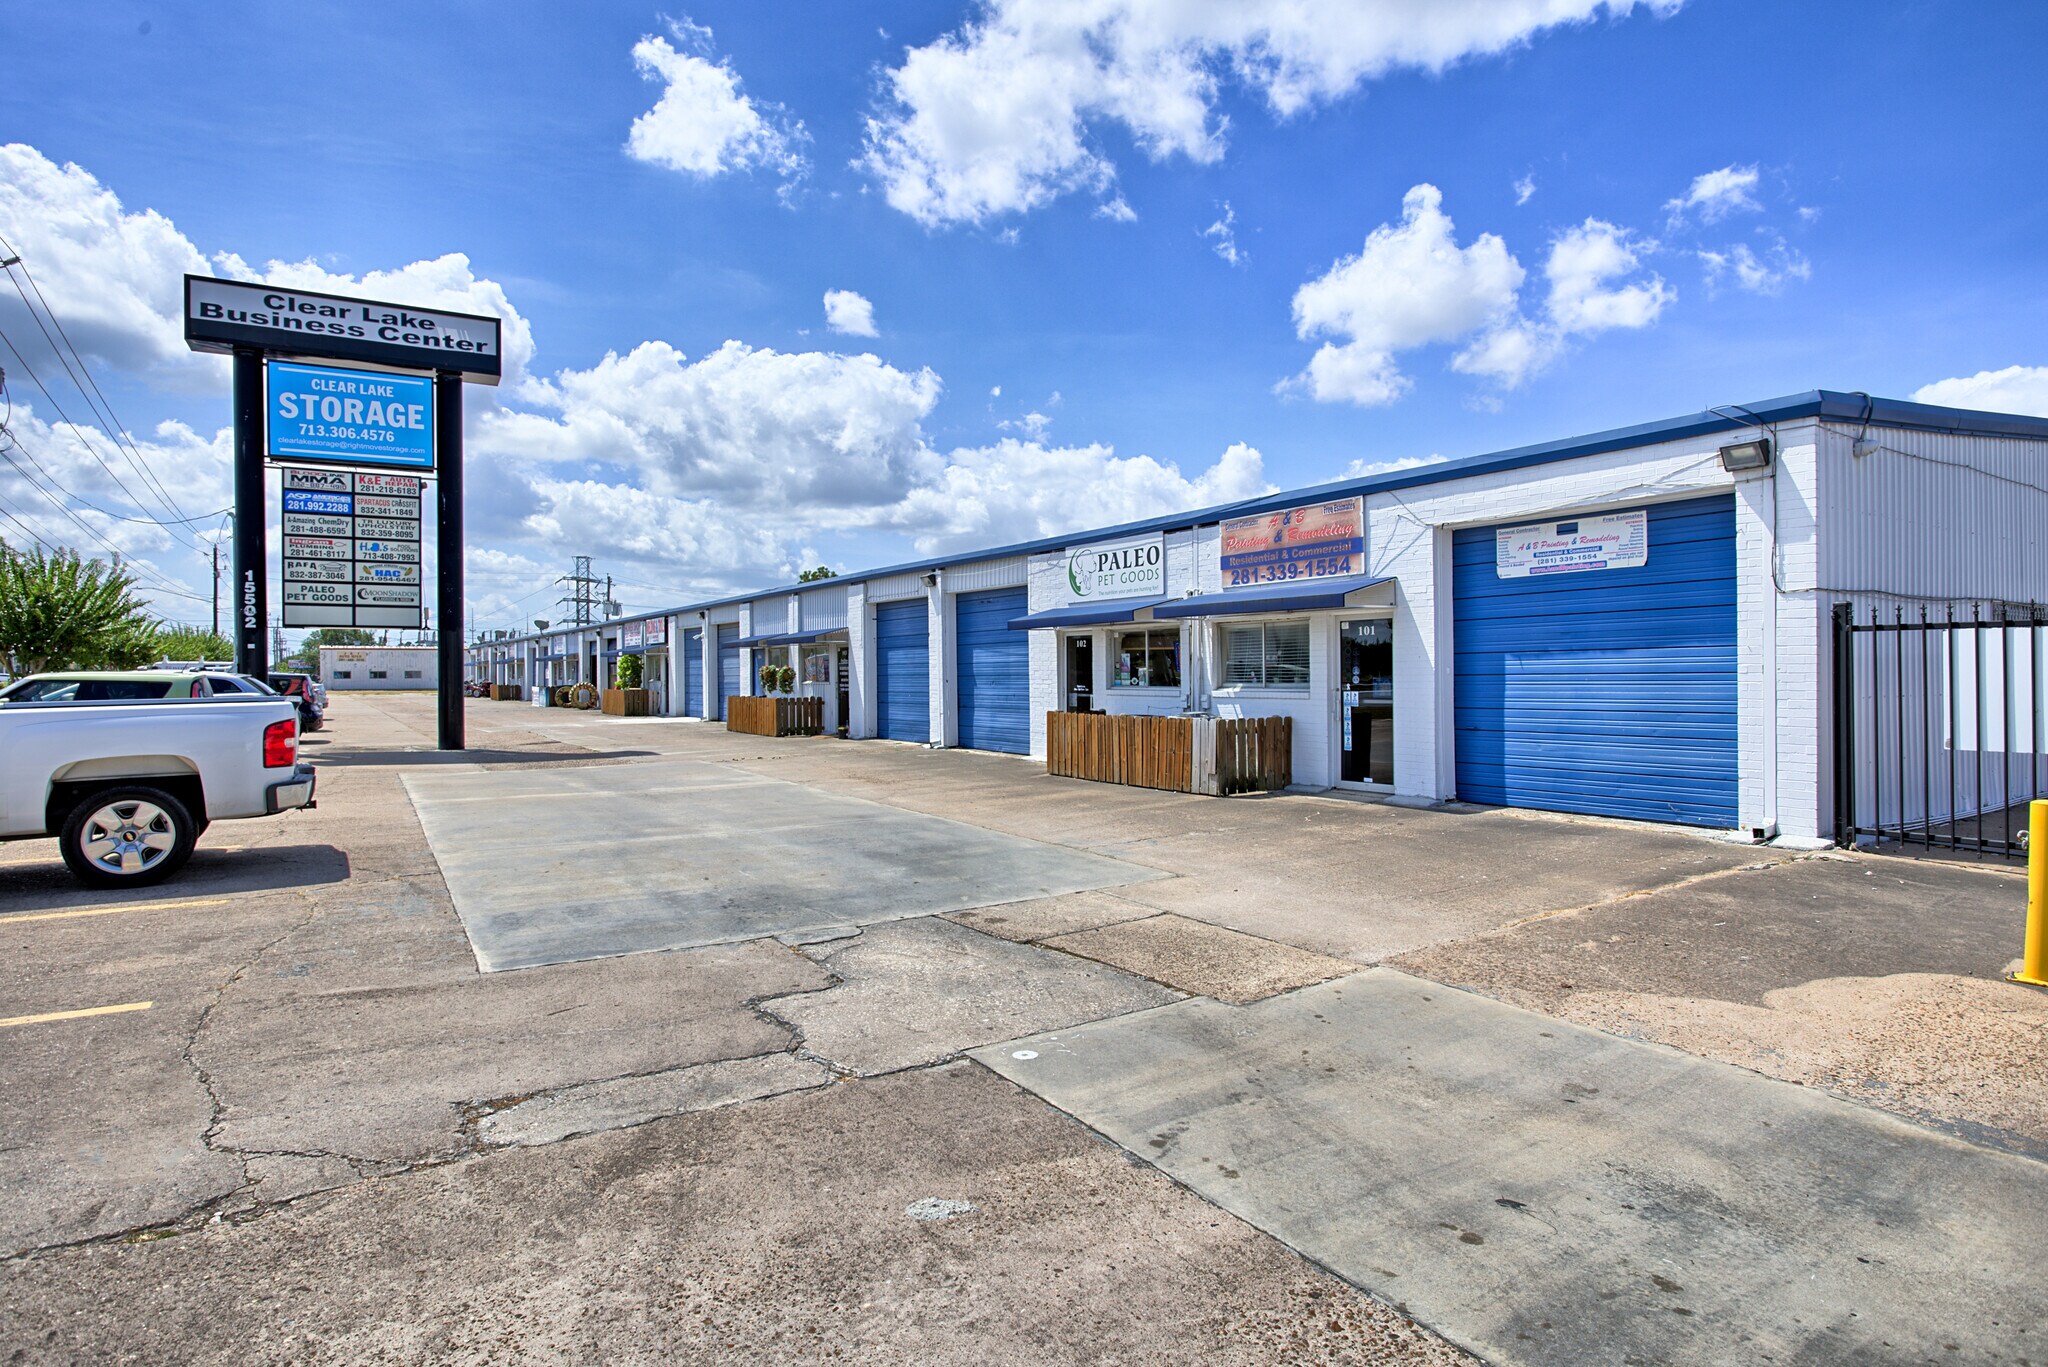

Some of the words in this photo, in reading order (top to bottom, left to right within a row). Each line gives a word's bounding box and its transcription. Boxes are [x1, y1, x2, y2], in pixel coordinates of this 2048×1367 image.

[264, 294, 351, 319] Clear
[362, 307, 435, 330] Lake
[200, 302, 365, 338] Business
[378, 326, 488, 353] Center
[311, 378, 356, 395] CLEAR
[359, 383, 394, 398] LAKE
[278, 392, 425, 430] STORAGE
[299, 423, 395, 442] 713.306.4576
[278, 436, 426, 455] clearlakestorage@rightmovestorage.com
[290, 474, 346, 485] MMA
[359, 475, 382, 485] K&E
[360, 485, 417, 495] 281-218-6183
[286, 492, 312, 500] ASP
[288, 500, 349, 512] 281.992.2288
[356, 498, 390, 507] SPARTACUS
[361, 506, 413, 516] 832-341-1849
[1323, 506, 1333, 515] Free
[287, 516, 315, 525] A-Amazing
[318, 517, 350, 527] ChemDry
[1268, 515, 1279, 530] A
[1283, 511, 1291, 526] &
[1616, 513, 1643, 521] Estimates
[290, 525, 346, 535] 281-488-6595
[361, 529, 414, 538] 832-359-8095
[1227, 535, 1269, 551] Painting
[1274, 529, 1282, 543] &
[1287, 523, 1354, 542] Remodeling
[1541, 540, 1569, 549] Painting
[1571, 537, 1577, 545] &
[1579, 534, 1620, 545] Remodeling
[290, 549, 346, 557] 281-461-8117
[1229, 552, 1279, 566] Residential
[1281, 551, 1288, 559] &
[1291, 542, 1351, 558] Commercial
[1569, 546, 1599, 554] Commercial
[363, 552, 415, 561] 713-408-7993
[1098, 545, 1160, 572] PALEO
[1537, 556, 1557, 565] (281)
[1559, 554, 1597, 562] 339-1554
[287, 561, 317, 570] RAFA
[1231, 556, 1351, 586] 281-339-1554
[289, 571, 345, 580] 832-387-3046
[1098, 573, 1115, 586] PET
[1120, 568, 1160, 584] GOODS
[301, 585, 336, 593] PALEO
[244, 570, 257, 628] 15502
[287, 593, 307, 601] PET
[312, 593, 349, 602] GOODS
[1358, 626, 1375, 636] 101
